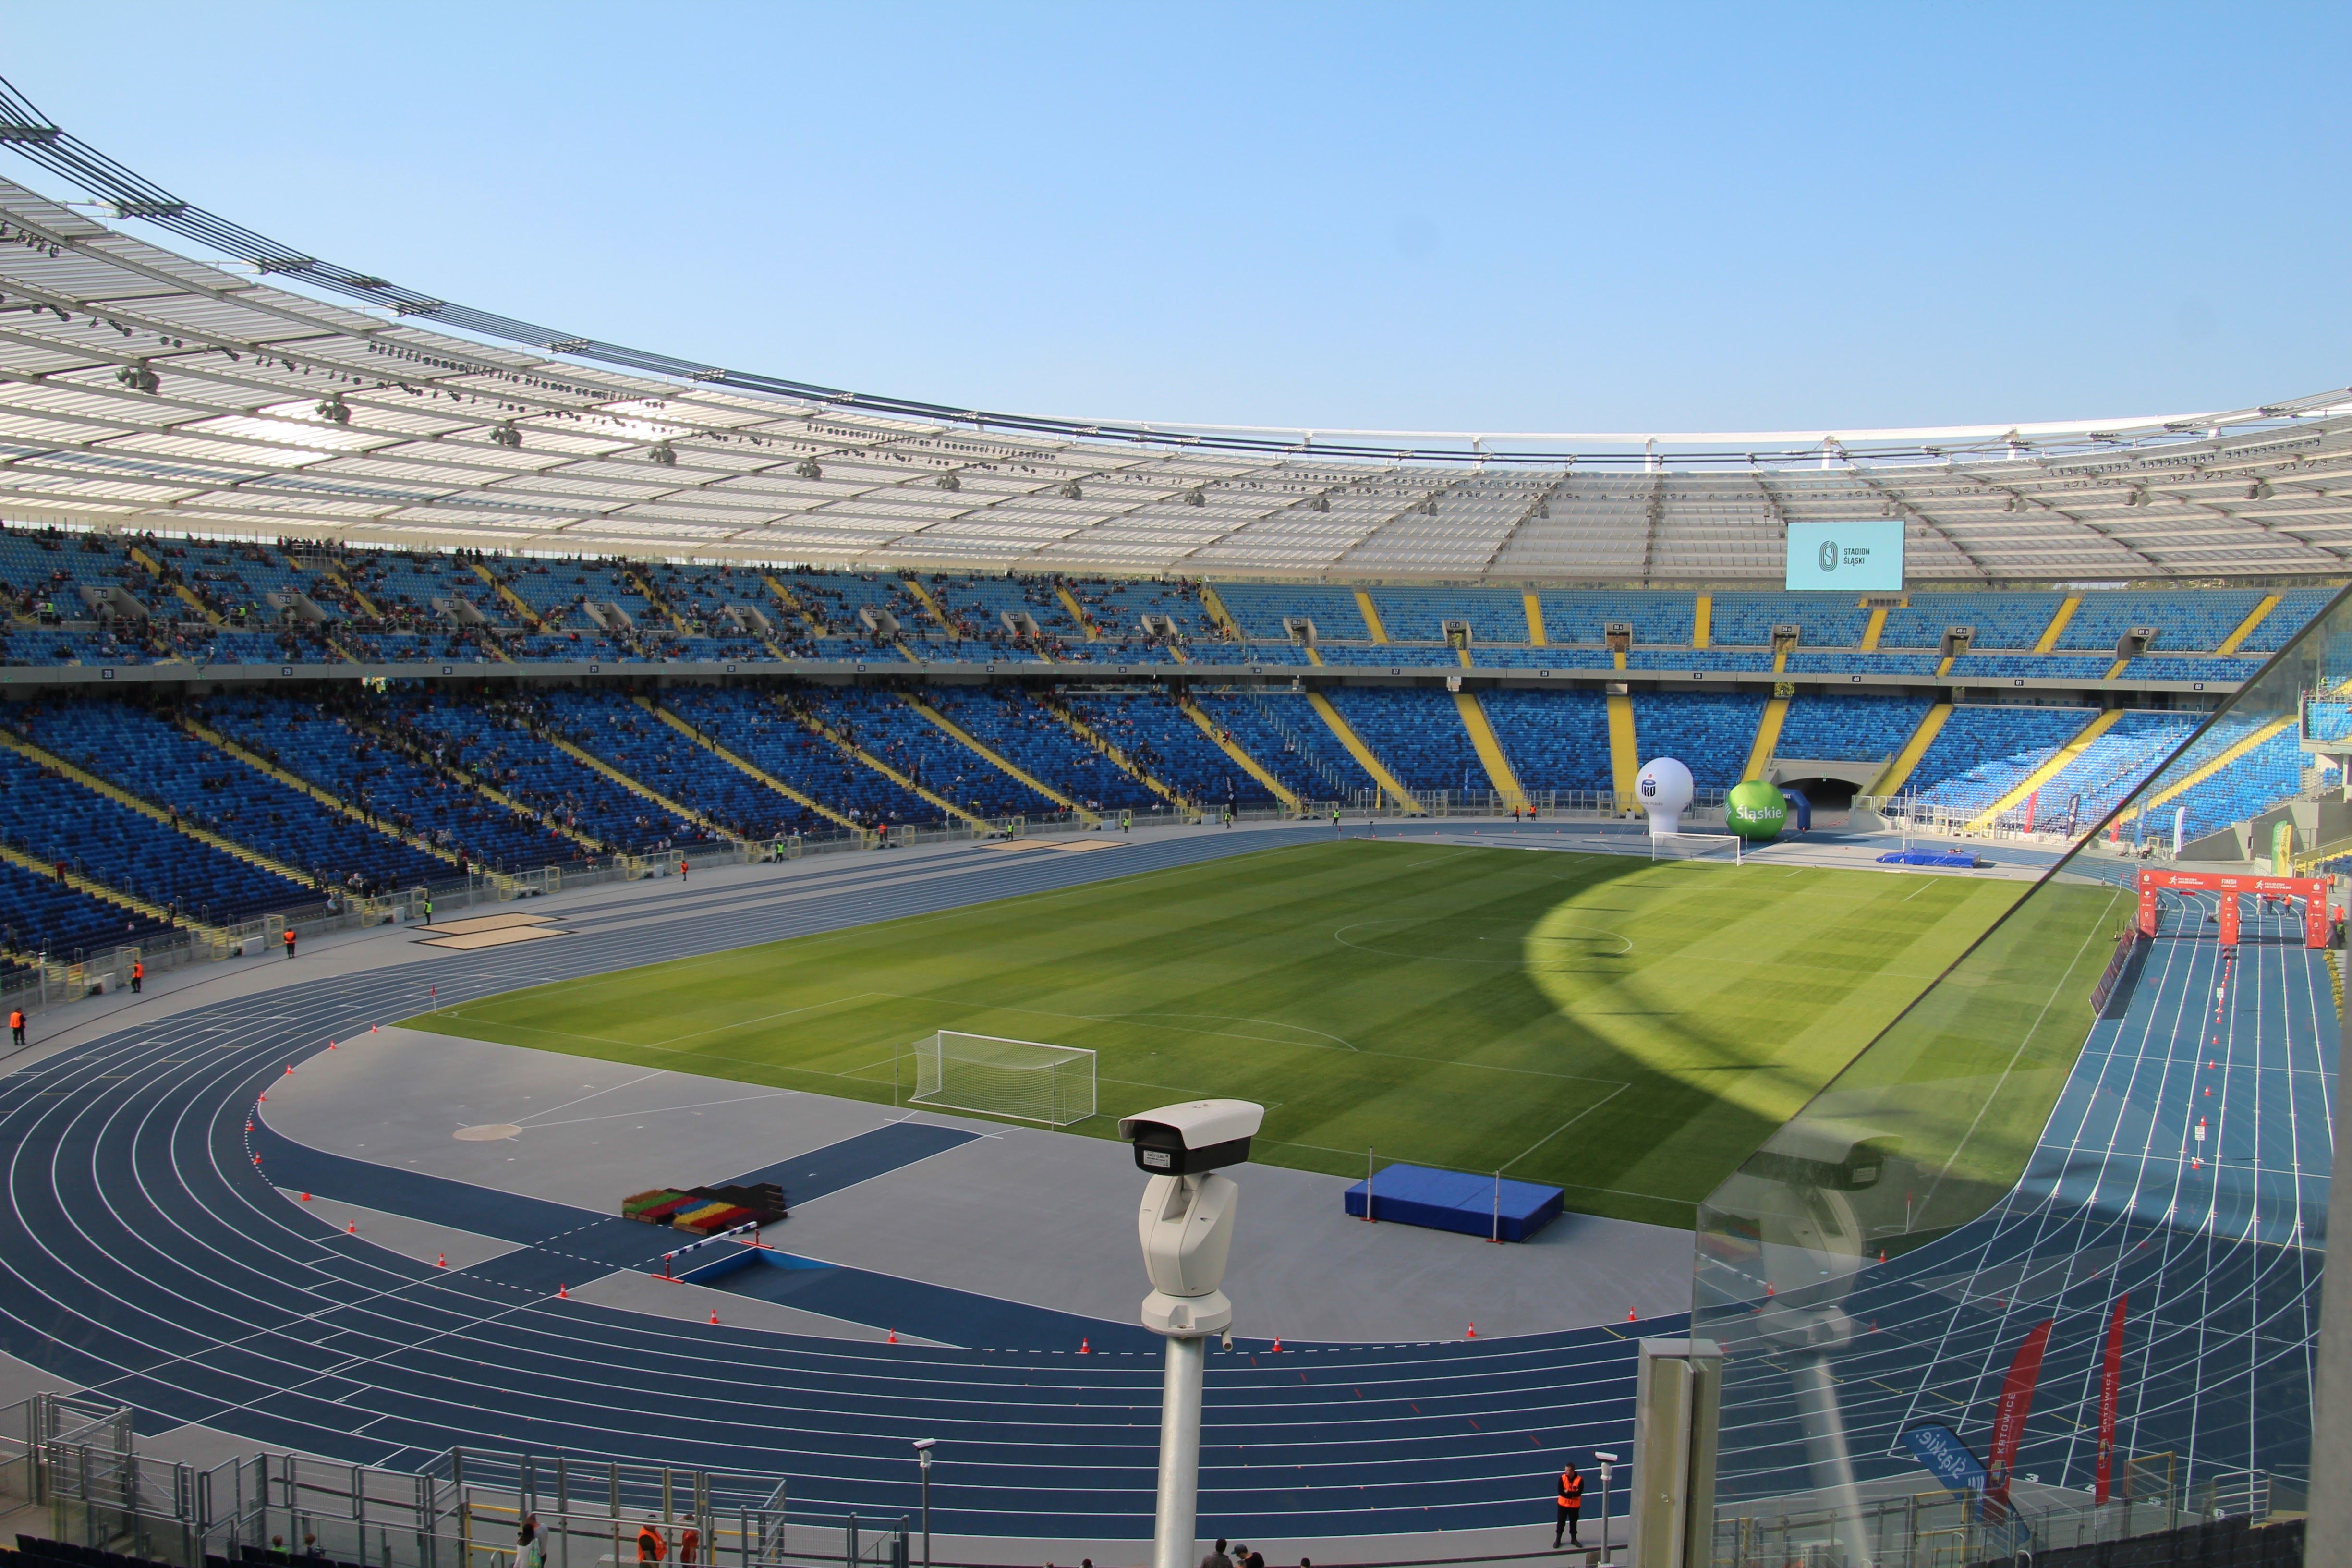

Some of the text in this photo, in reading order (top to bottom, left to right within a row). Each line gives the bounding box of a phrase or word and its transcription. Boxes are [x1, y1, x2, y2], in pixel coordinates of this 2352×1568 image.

[1843, 556, 1865, 567] ŚLĄSKI
[1736, 804, 1783, 823] Śląskie.
[2102, 1372, 2111, 1433] KATOWICE
[1997, 1393, 2016, 1454] KATOWICE
[2025, 1473, 2039, 1483] 3
